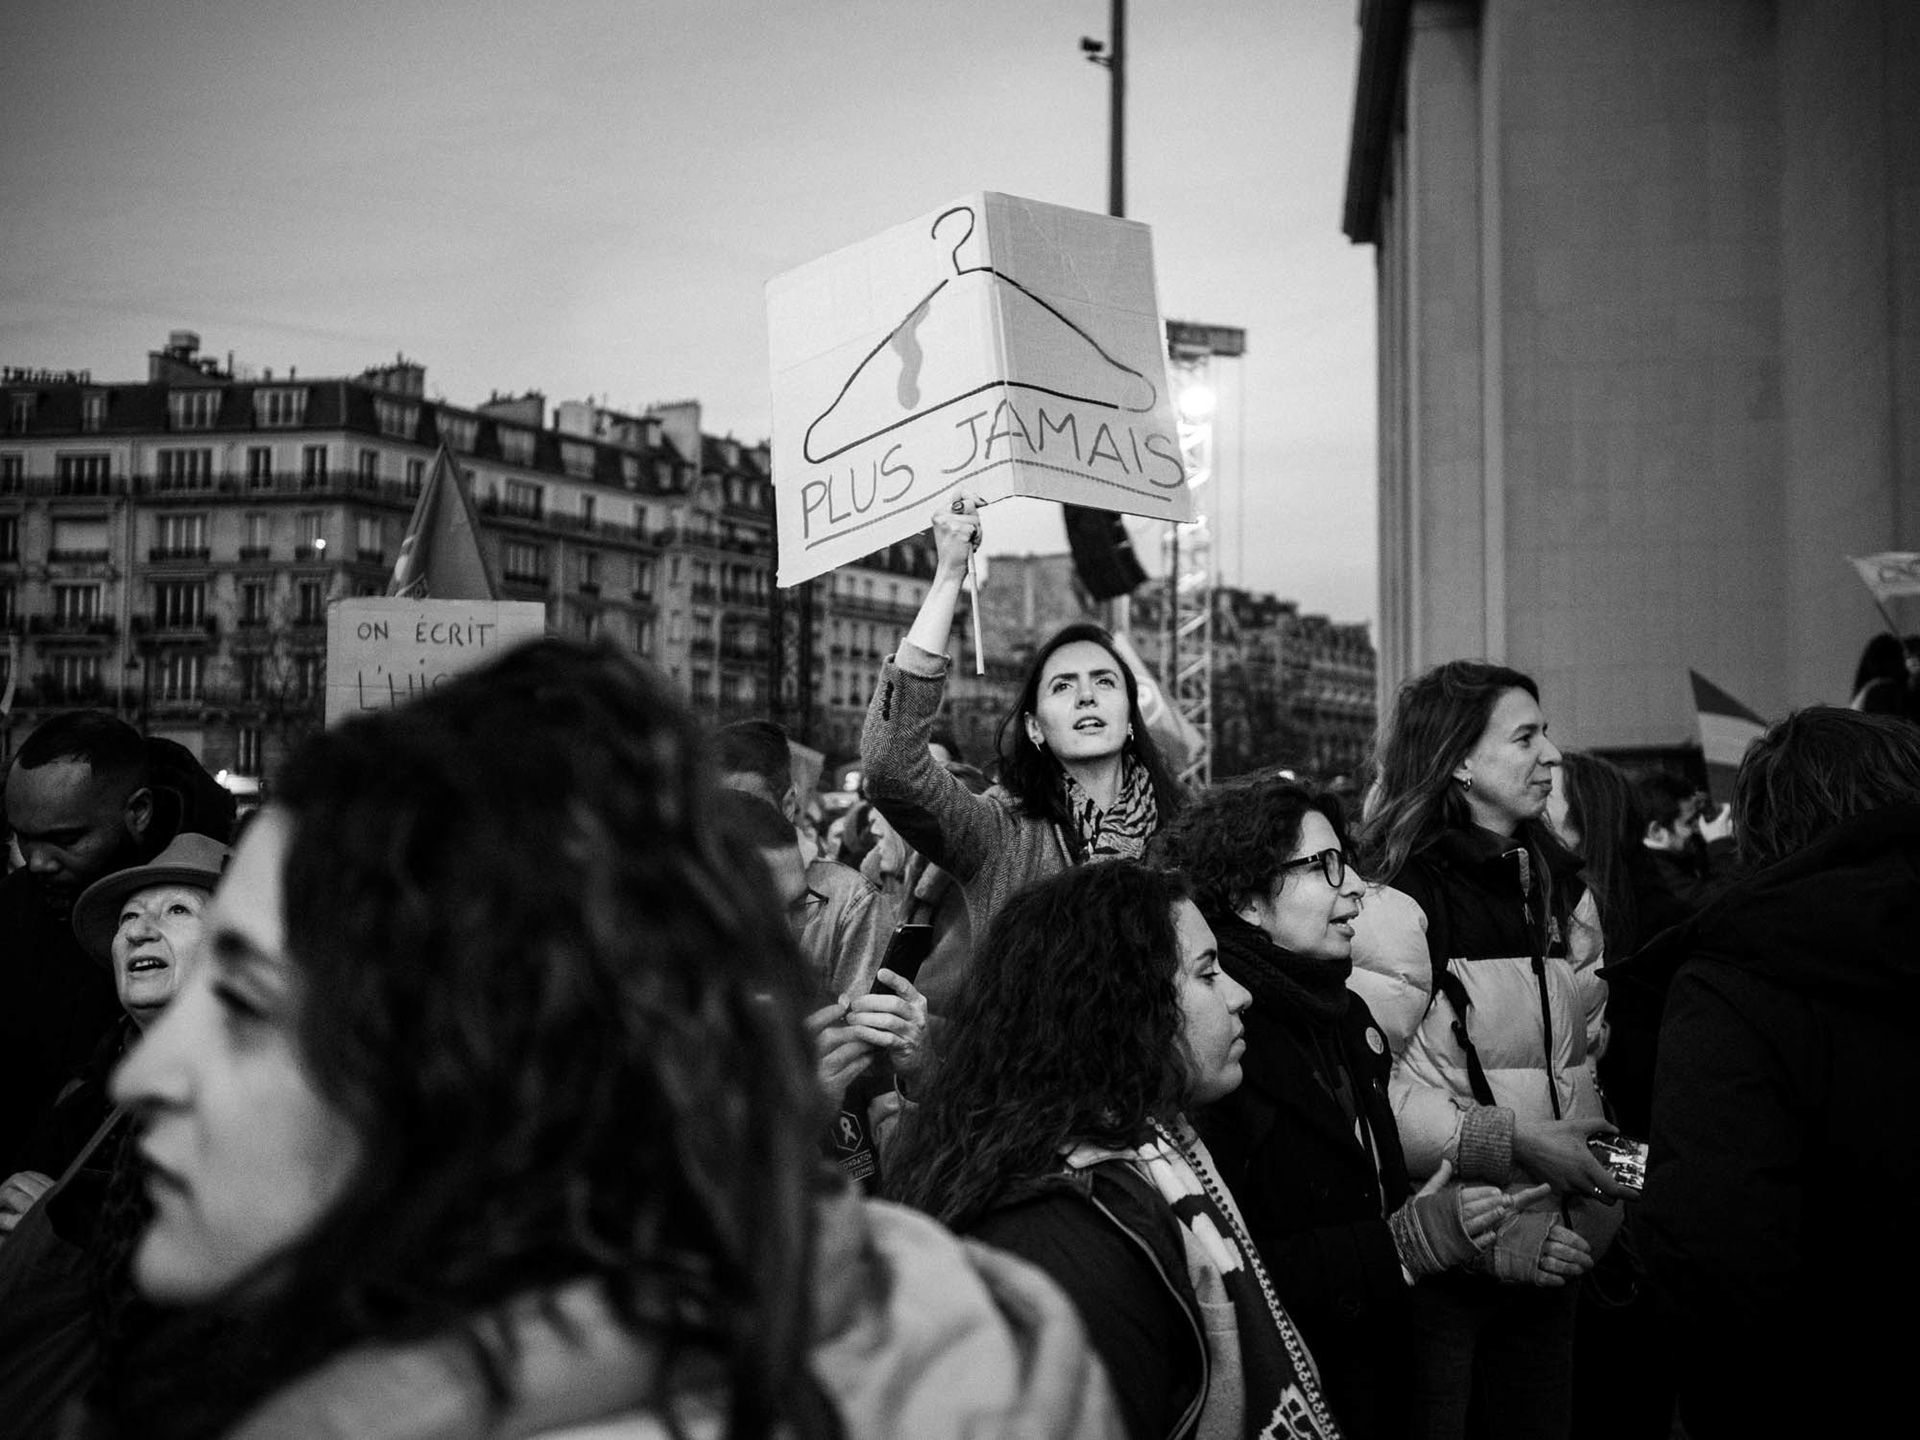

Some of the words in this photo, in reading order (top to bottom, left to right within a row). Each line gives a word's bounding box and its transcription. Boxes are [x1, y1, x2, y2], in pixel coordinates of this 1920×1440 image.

[801, 443, 915, 539] PLUS
[942, 398, 1185, 489] JAMAIS
[357, 620, 389, 641] ON
[415, 613, 496, 648] ÉCRIT
